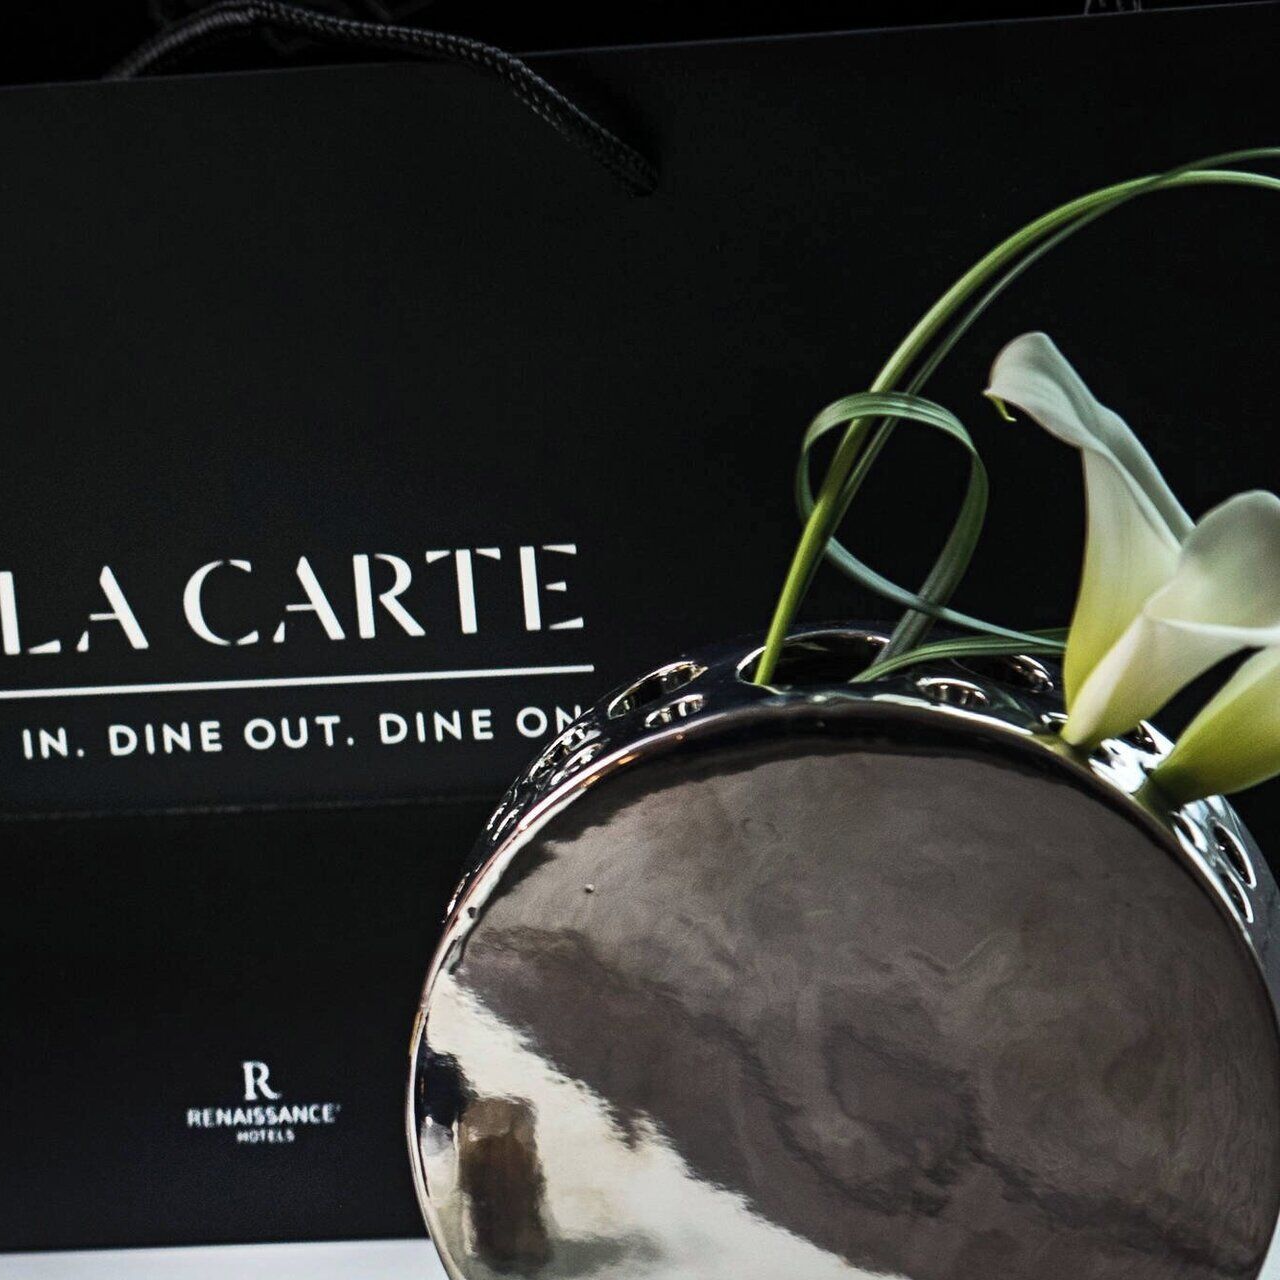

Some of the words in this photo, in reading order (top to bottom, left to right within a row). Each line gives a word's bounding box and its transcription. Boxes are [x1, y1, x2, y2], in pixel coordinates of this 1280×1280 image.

[182, 543, 584, 647] CARTE
[22, 726, 85, 760] IN.
[108, 720, 223, 757] DINE
[243, 714, 355, 751] OUT.
[378, 708, 494, 745] DINE
[242, 1060, 282, 1102] R
[187, 1103, 336, 1128] RENAISSANCE
[236, 1128, 296, 1144] HOTELS
